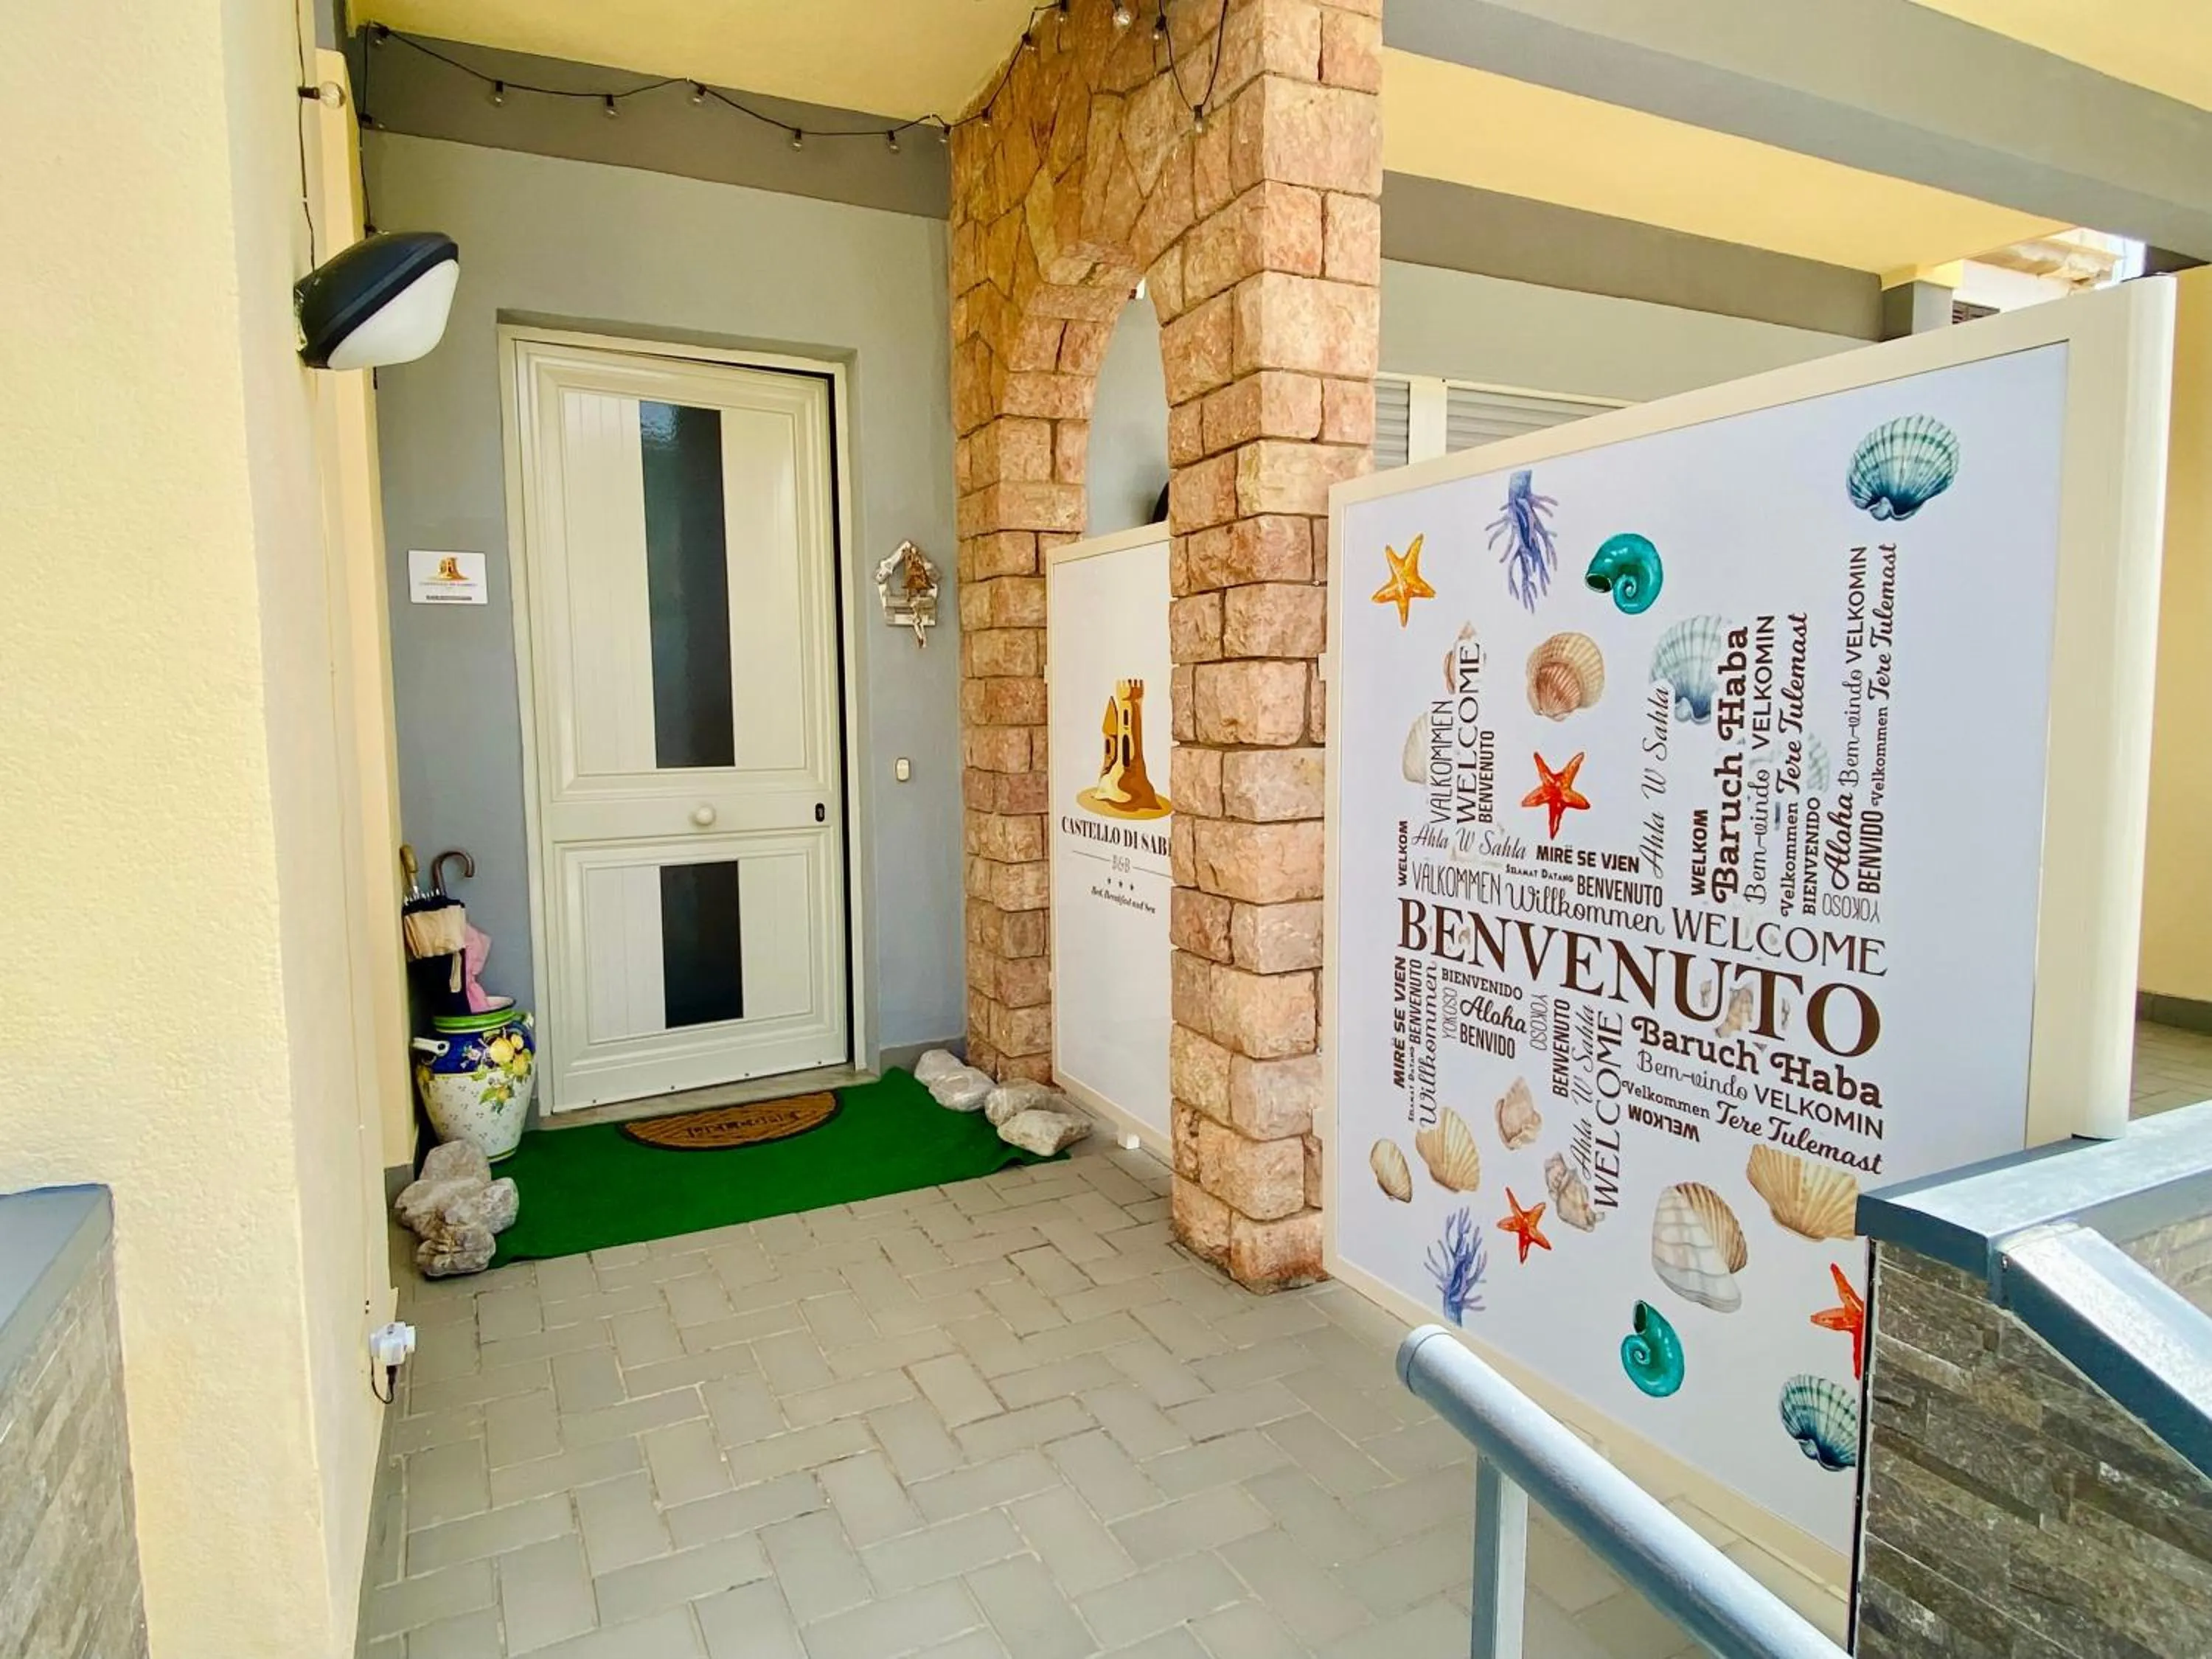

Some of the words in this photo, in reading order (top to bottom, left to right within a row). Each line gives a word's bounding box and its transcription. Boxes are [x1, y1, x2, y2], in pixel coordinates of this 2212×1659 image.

[1870, 543, 1898, 647] Tulemast
[1717, 626, 1748, 741] Haba
[1751, 616, 1775, 751] VELKOMIN
[1778, 613, 1808, 734] Tulemast
[1868, 652, 1892, 700] Tere
[1457, 642, 1479, 824] WELCOME
[1823, 792, 1853, 891] Aloha
[1845, 546, 1868, 665] VELKOMIN
[1871, 706, 1888, 807] Velkommen
[1478, 730, 1495, 824] BENVENUTO
[1775, 740, 1802, 795] Tere
[1062, 815, 1121, 845] CASTELLO
[1124, 829, 1138, 849] DI
[1398, 820, 1408, 886] WELKOM
[1577, 850, 1597, 868] SE
[1601, 852, 1640, 874] VJEN
[1691, 809, 1708, 896] WELKOM
[1711, 752, 1743, 904] Baruch
[1781, 802, 1798, 917] Velkommen
[1802, 797, 1820, 916] BIENVENIDO
[1857, 810, 1884, 894] BENVIDO
[1505, 883, 1665, 936] Willkommen
[1576, 874, 1663, 908] BENVENUTO
[1394, 956, 1406, 1002] VJEN
[1398, 898, 1881, 1057] BENVENUTO
[1441, 967, 1523, 1001] BIENVENIDO
[1671, 907, 1888, 977] WELCOME
[1394, 1008, 1406, 1034] SE
[1409, 959, 1422, 1045] BENVENUTO
[1419, 960, 1437, 1127] Willkommen
[1442, 987, 1458, 1040] YOKOSO
[1460, 995, 1527, 1034] Aloha
[1460, 1023, 1516, 1060] BENVIDO
[1529, 994, 1549, 1051] YOKOSO
[1552, 999, 1571, 1098] BENVENUTO
[1631, 1015, 1759, 1075] Baruch
[1770, 1051, 1882, 1109] Haba
[1593, 1011, 1623, 1208] WELCOME
[1621, 1079, 1711, 1120] Velkommen
[1717, 1100, 1763, 1136] Tere
[1768, 1116, 1882, 1175] Tulemast
[1627, 1104, 1700, 1142] WELKOM
[1753, 1083, 1883, 1141] VELKOMIN
